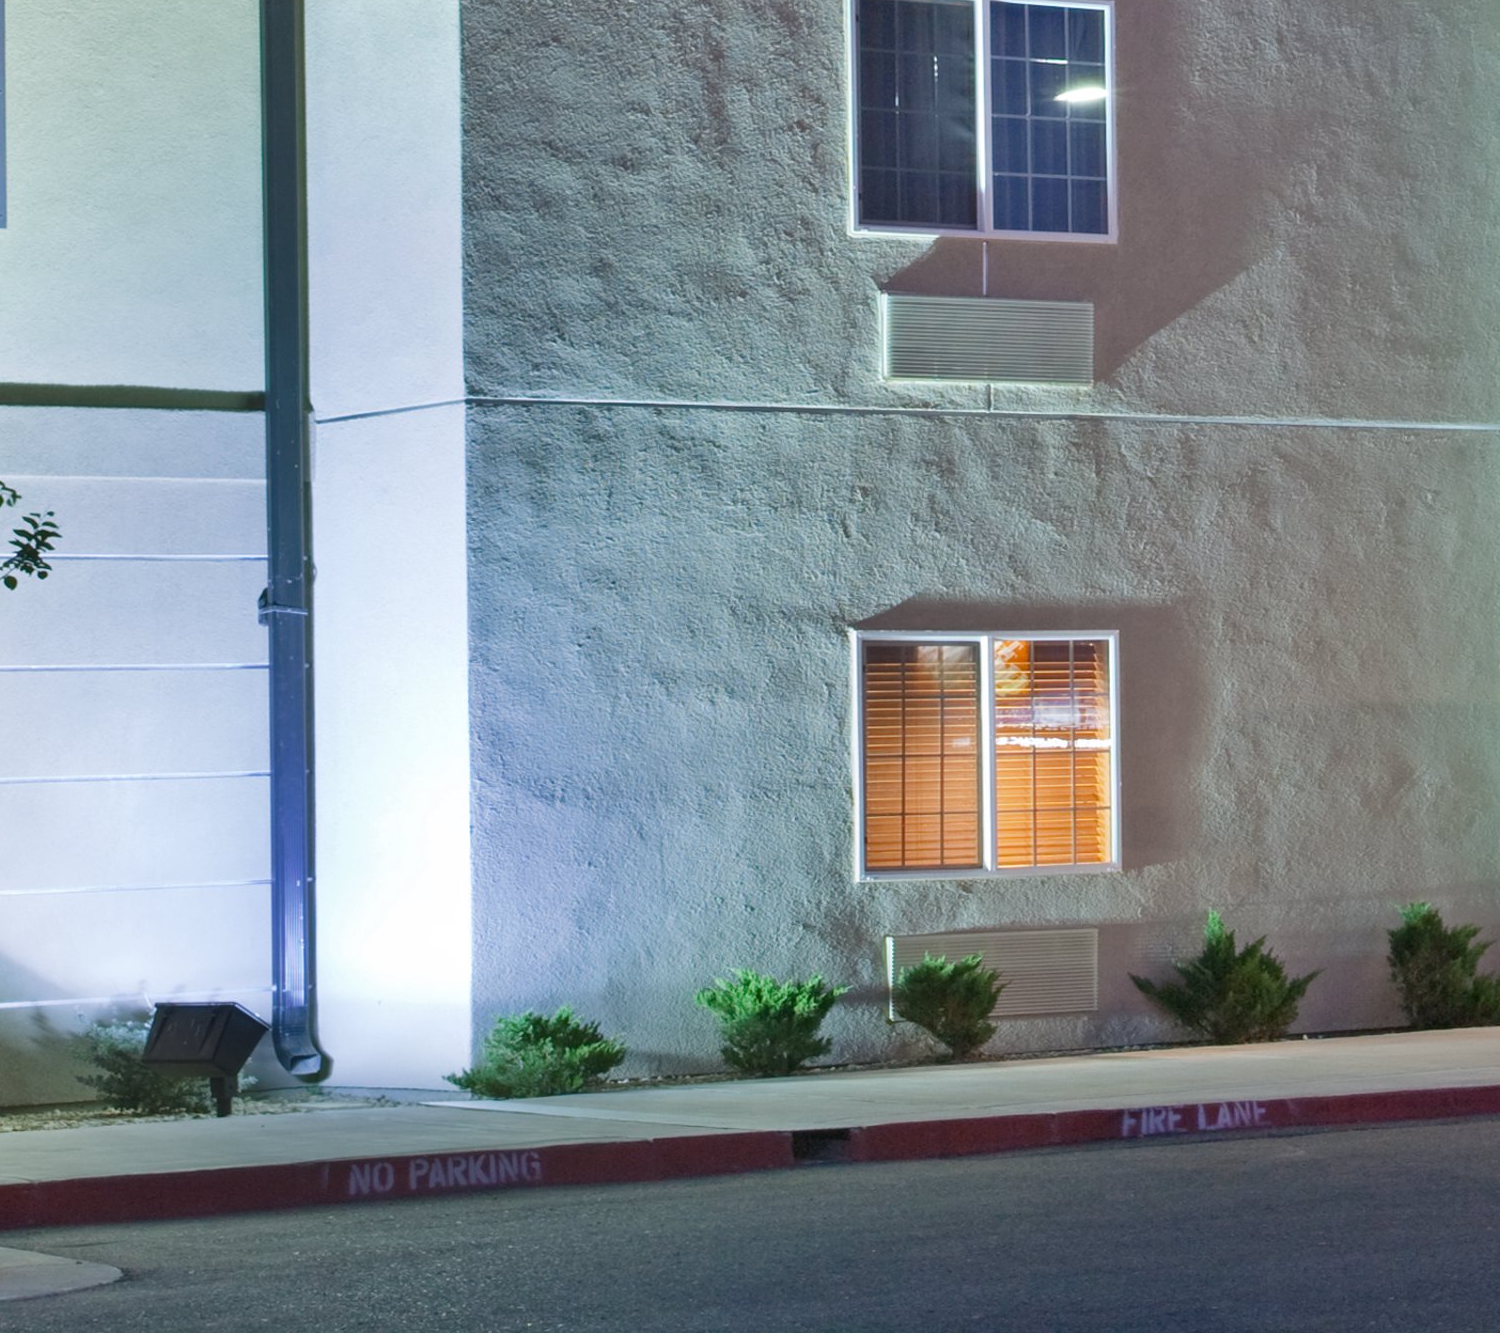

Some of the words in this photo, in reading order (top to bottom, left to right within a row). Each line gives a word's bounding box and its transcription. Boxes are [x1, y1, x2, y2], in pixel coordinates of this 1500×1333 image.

[1121, 1102, 1188, 1137] FIRE
[1197, 1099, 1272, 1132] LANE
[348, 1162, 395, 1196] NO
[408, 1151, 543, 1190] PARKING
